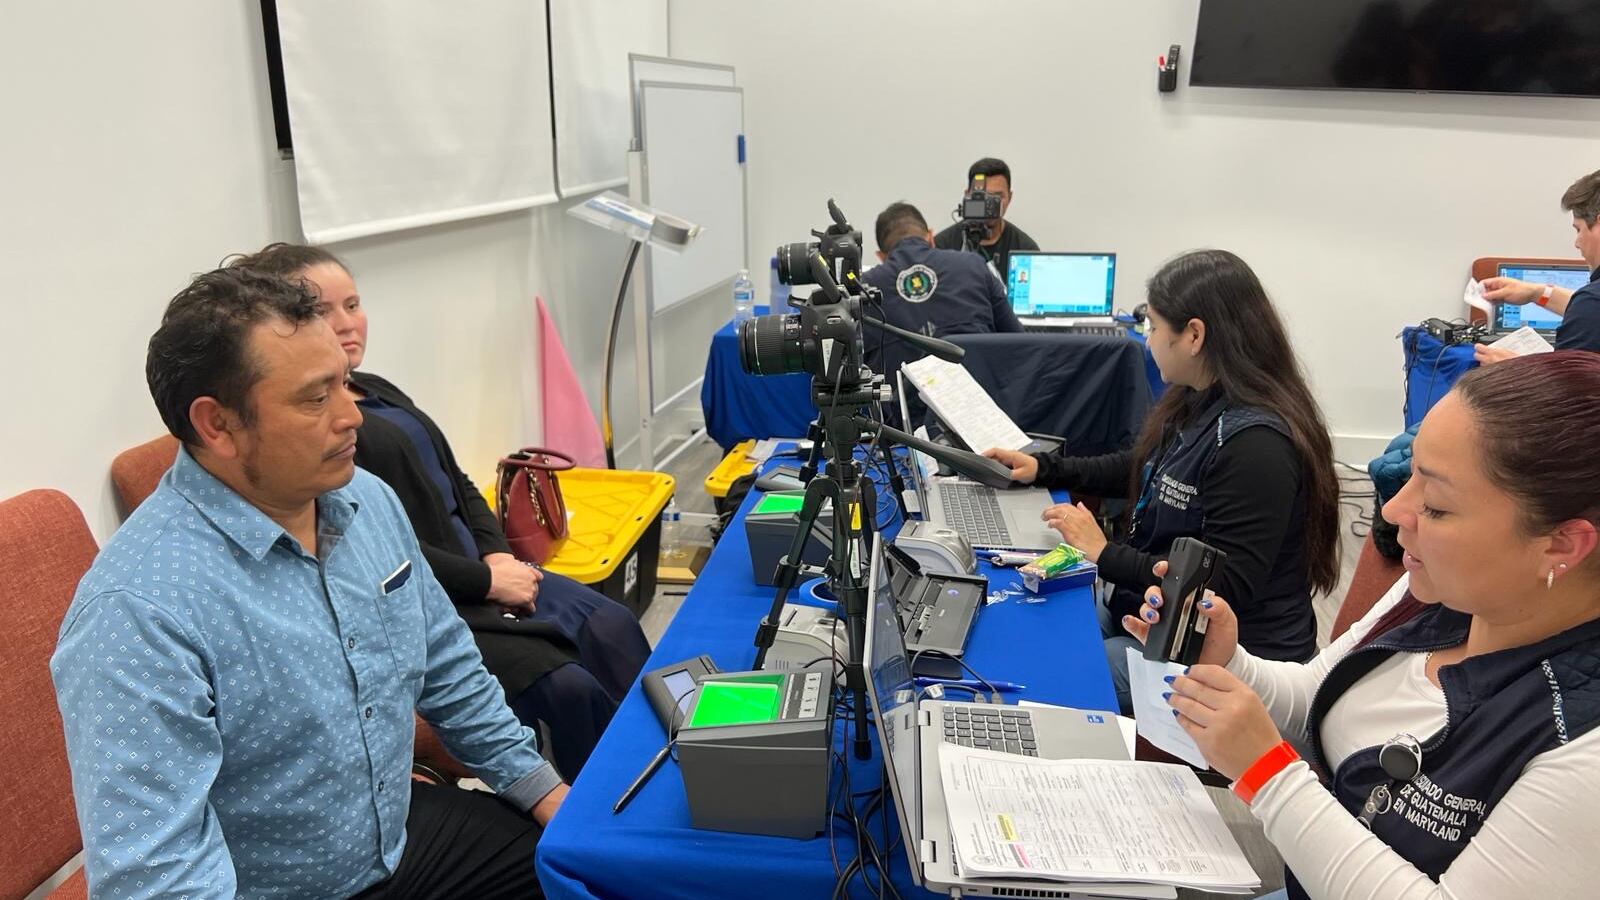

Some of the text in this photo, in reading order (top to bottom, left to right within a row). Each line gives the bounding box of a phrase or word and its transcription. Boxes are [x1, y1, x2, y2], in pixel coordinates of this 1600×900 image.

[1392, 797, 1461, 842] EN MARYLAND
[1400, 784, 1467, 827] DE GUATEMALA
[1444, 793, 1487, 816] GENERAL
